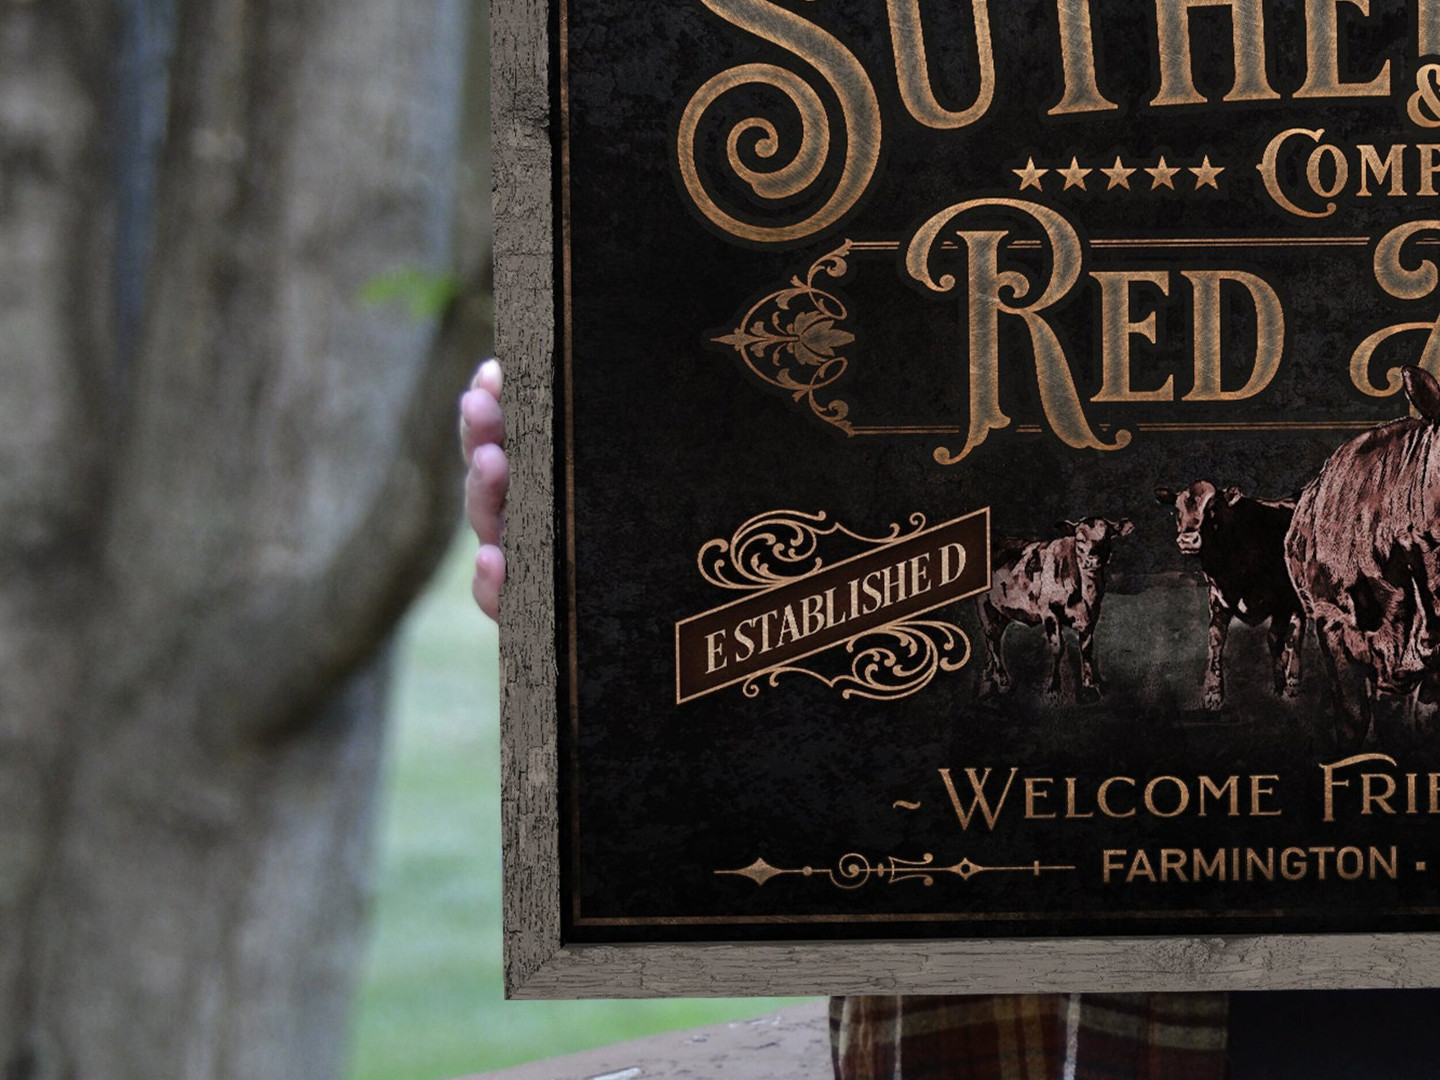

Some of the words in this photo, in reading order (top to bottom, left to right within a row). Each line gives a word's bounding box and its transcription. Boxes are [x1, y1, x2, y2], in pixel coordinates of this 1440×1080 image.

[906, 197, 1286, 465] RED
[703, 542, 967, 675] ESTABLISHED
[937, 766, 1283, 831] WELCOME
[1102, 844, 1398, 884] FARMINGTON
